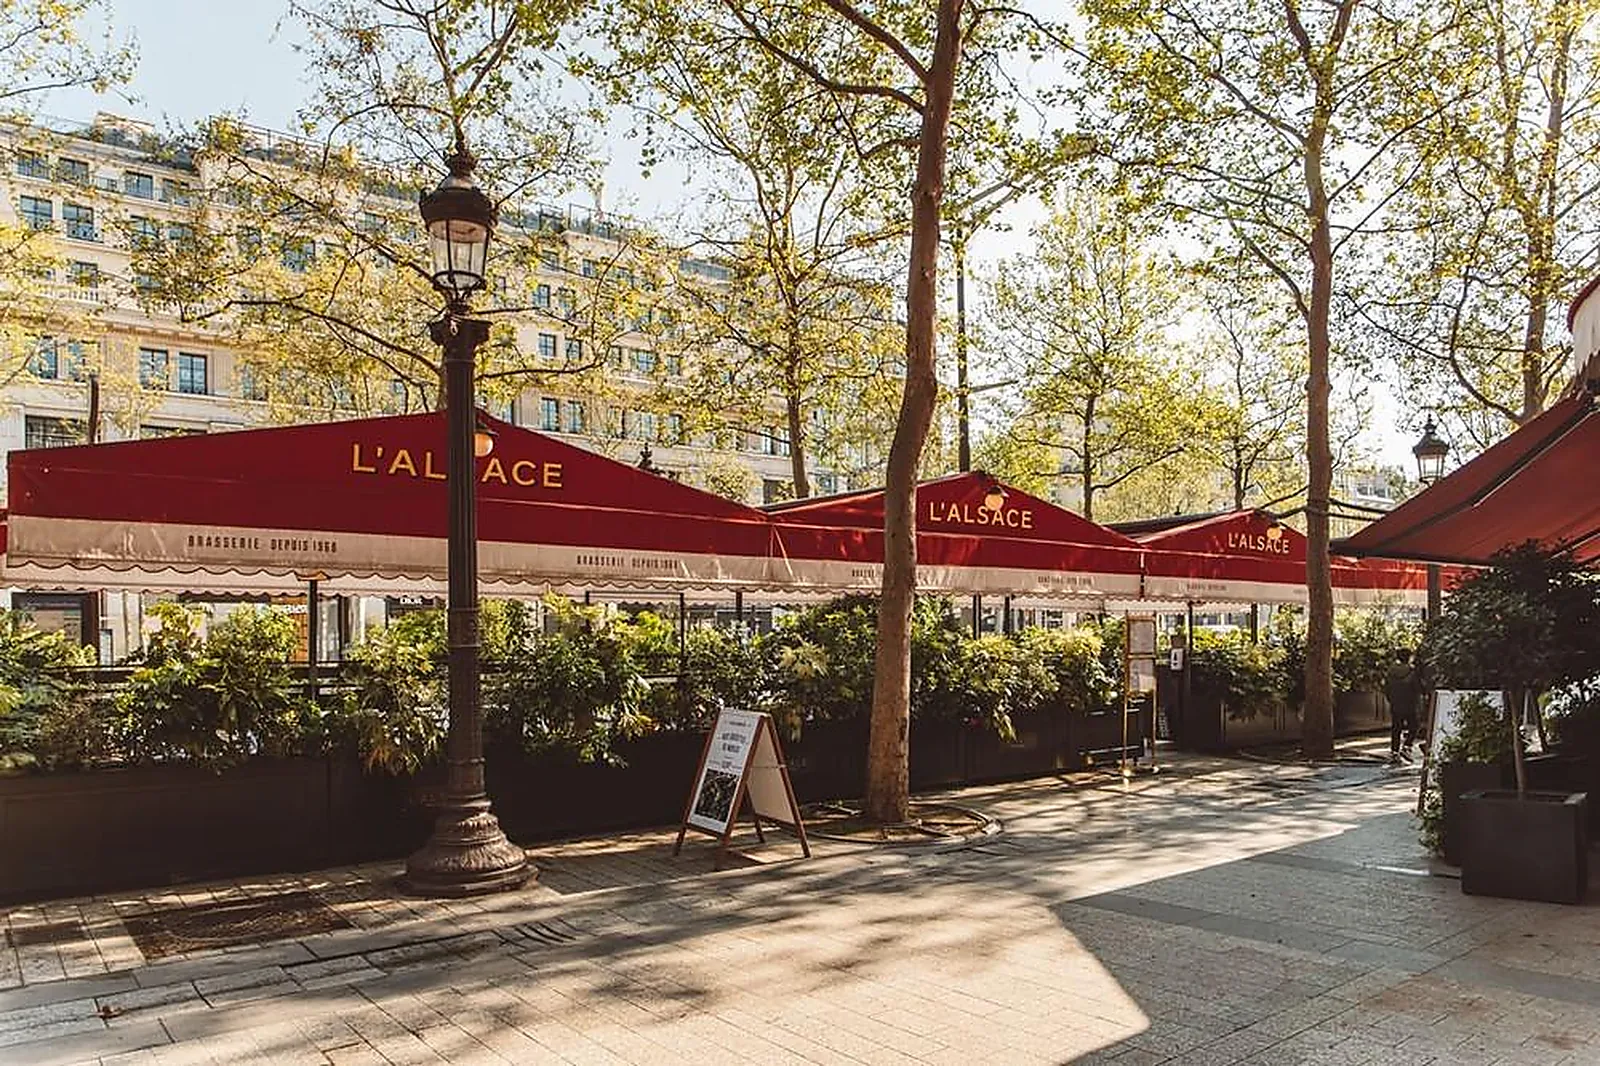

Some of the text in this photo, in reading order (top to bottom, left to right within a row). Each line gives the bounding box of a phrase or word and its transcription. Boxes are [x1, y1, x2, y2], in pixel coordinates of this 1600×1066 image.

[352, 443, 563, 488] L'ALACE
[930, 501, 1033, 529] L'ALSACE
[188, 535, 260, 550] BRASSERIE
[270, 538, 308, 551] DEPUIS
[1228, 532, 1290, 554] L'ALSACE
